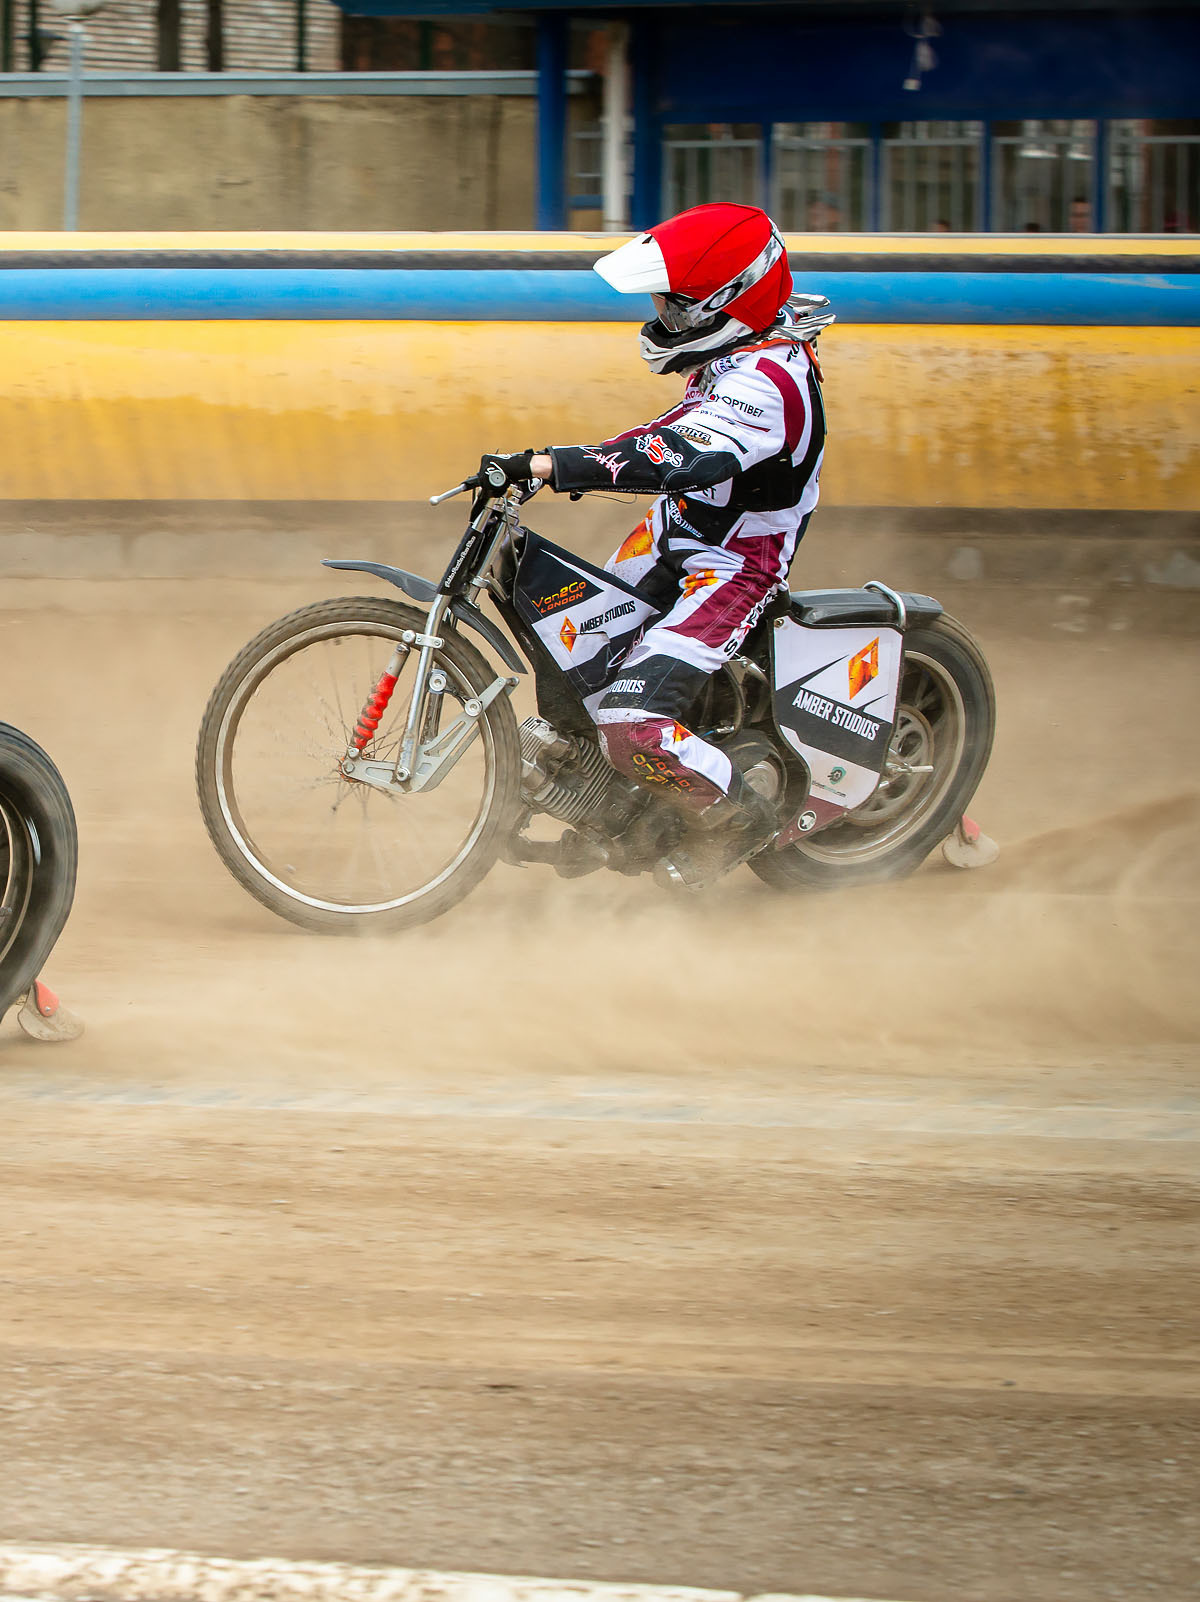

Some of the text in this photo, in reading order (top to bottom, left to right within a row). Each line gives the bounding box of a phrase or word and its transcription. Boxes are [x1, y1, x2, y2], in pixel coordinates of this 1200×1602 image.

[722, 395, 765, 418] OPTIBET
[580, 600, 636, 634] AMBER STUDIOS
[606, 679, 646, 693] UDIOS
[791, 689, 880, 741] AMBER STUDIOS
